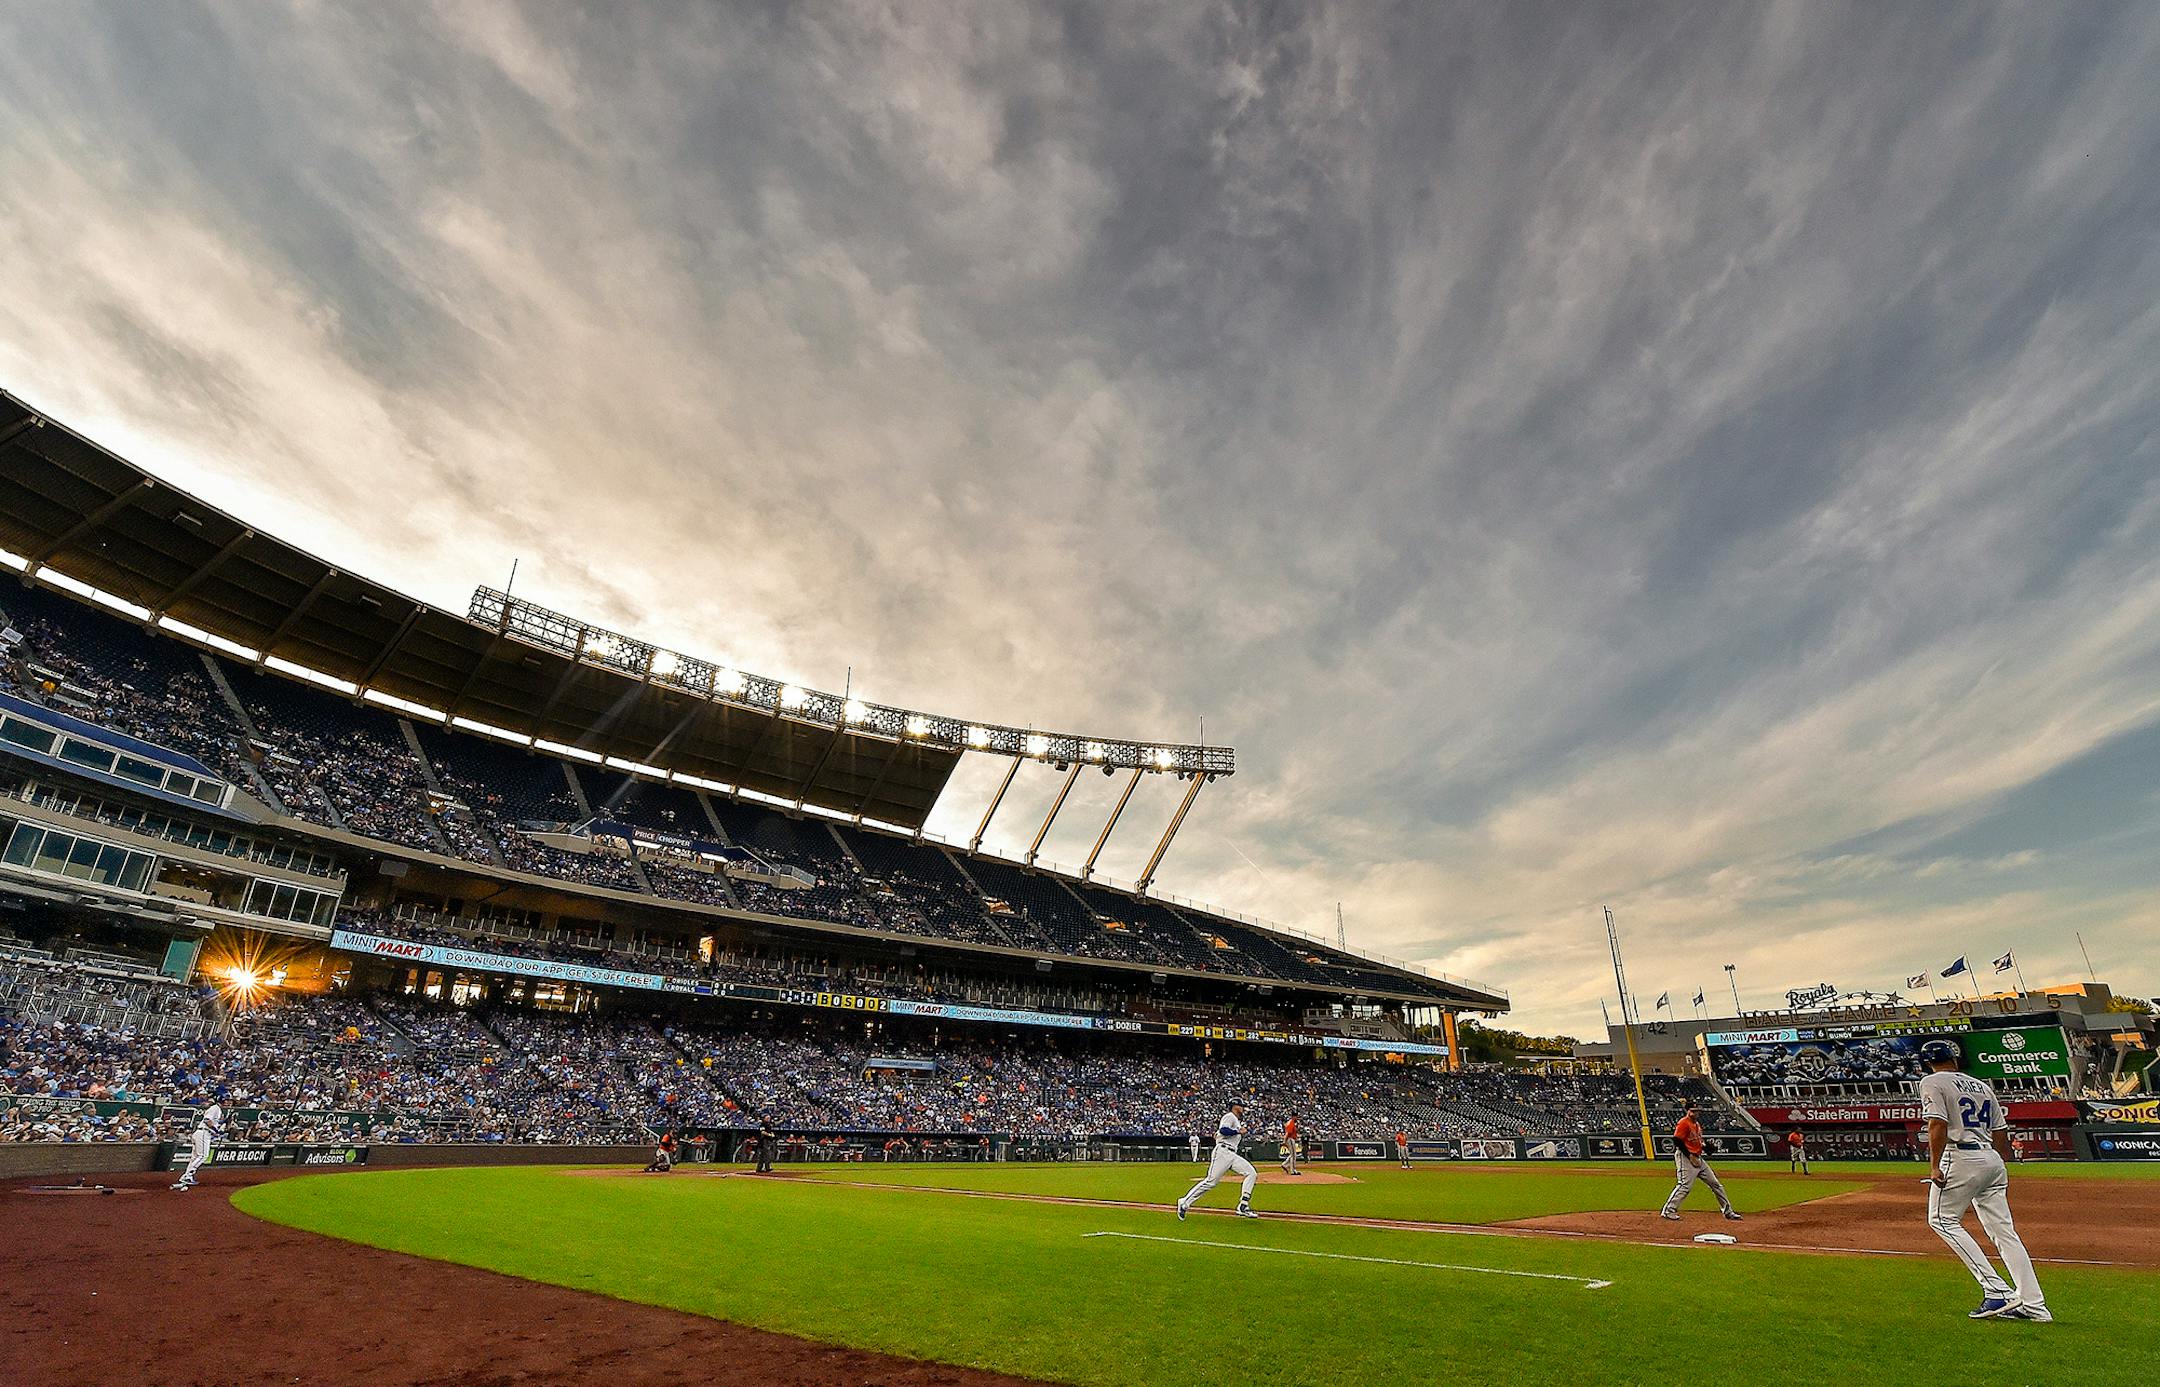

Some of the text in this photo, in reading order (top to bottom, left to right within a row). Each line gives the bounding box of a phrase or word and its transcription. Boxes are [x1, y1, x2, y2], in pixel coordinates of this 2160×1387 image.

[634, 830, 690, 847] PRICE CHOPPER
[343, 931, 378, 948] MINIT
[374, 941, 425, 957] MART
[446, 952, 513, 969] DOWNLOAD
[515, 961, 539, 972] OUR
[568, 968, 588, 977] GET
[591, 970, 621, 981] STUFF
[672, 977, 700, 986] ORIOLES
[672, 985, 696, 993] ROYALS
[1786, 982, 1838, 1008] Royals
[821, 994, 828, 1005] B
[879, 1001, 887, 1010] 2
[1948, 1000, 1974, 1017] 20
[1999, 997, 2018, 1014] 10
[2048, 994, 2062, 1010] 5
[914, 1004, 943, 1015] MART
[1743, 1011, 1807, 1028] HALL
[1827, 1004, 1897, 1023] FAME
[1115, 1021, 1142, 1032] DOZIER
[1225, 1029, 1234, 1038] 23
[1647, 1021, 1668, 1035] 42
[1817, 1029, 1824, 1037] 6
[1719, 1031, 1781, 1043] MINIT MART
[1801, 1055, 1825, 1071] 50
[1977, 1049, 2059, 1064] Commerce
[2003, 1061, 2042, 1075] Bank
[1952, 1078, 1986, 1095] MAIER
[326, 1113, 350, 1125] CLUB
[1806, 1108, 1869, 1121] StateFarm
[1957, 1096, 1991, 1128] 24
[2095, 1106, 2157, 1119] SONIC
[2115, 1141, 2160, 1150] KONICA
[216, 1150, 267, 1162] H&R BLOCK
[305, 1152, 345, 1165] Advisors
